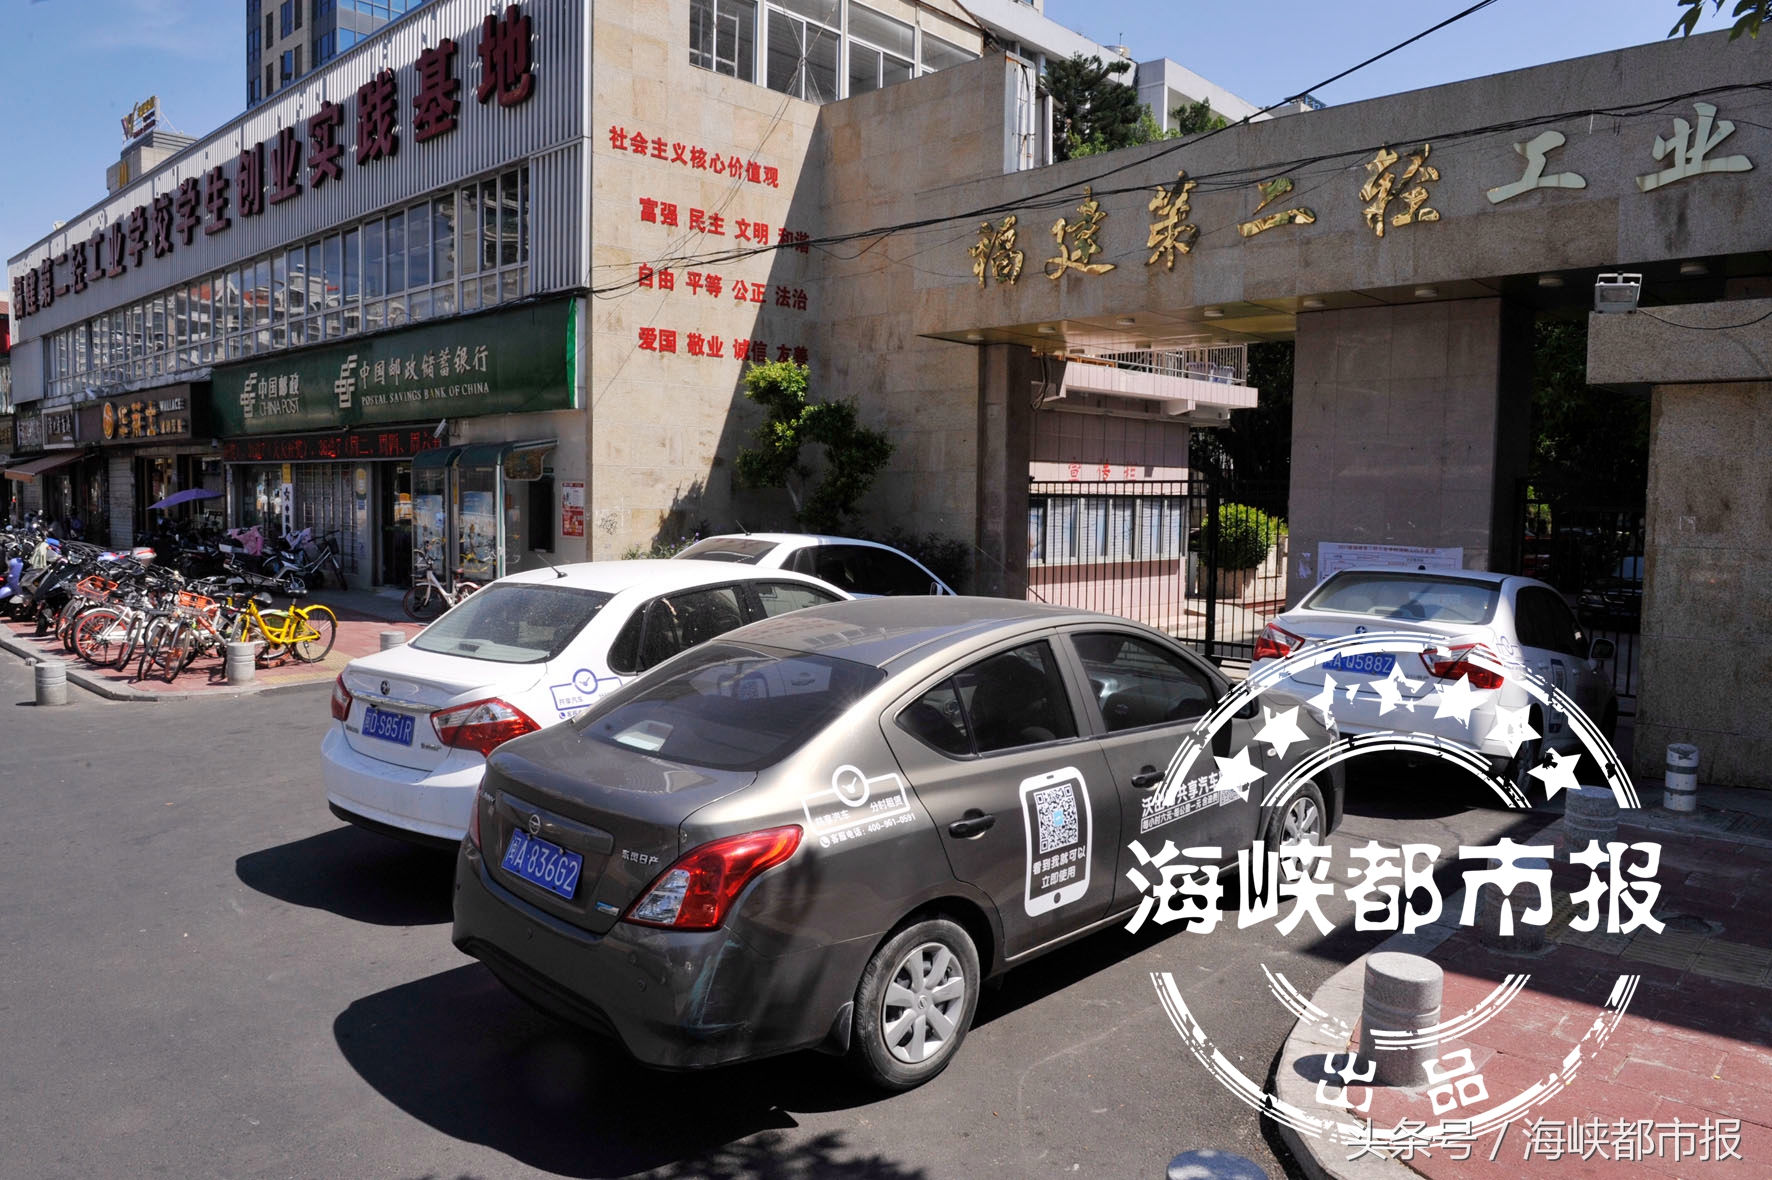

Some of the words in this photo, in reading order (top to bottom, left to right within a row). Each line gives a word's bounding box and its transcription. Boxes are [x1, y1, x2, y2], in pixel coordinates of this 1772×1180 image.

[609, 125, 779, 188] 社会主义核心价值观
[639, 197, 678, 228] 富强
[689, 207, 725, 236] 民主
[735, 218, 769, 245] 文明
[638, 262, 674, 291] 自由
[686, 271, 722, 298] 平等
[732, 280, 766, 303] 公正
[775, 286, 808, 311] 法治
[638, 327, 677, 353] 爱国
[687, 332, 723, 358] 敬业
[733, 338, 768, 363] 诚信
[359, 345, 489, 390] 中国邮政储蓄银行
[258, 371, 299, 400] 中国邮政
[361, 393, 388, 406] POSTAL
[389, 389, 422, 403] SAVINGS
[424, 385, 448, 400] BANK
[449, 384, 460, 397] OF
[461, 381, 490, 396] CHINA
[260, 399, 282, 416] CHINA
[281, 397, 299, 414] POST
[1032, 845, 1086, 876] 看到我就可以
[1041, 865, 1076, 889] 立即使用
